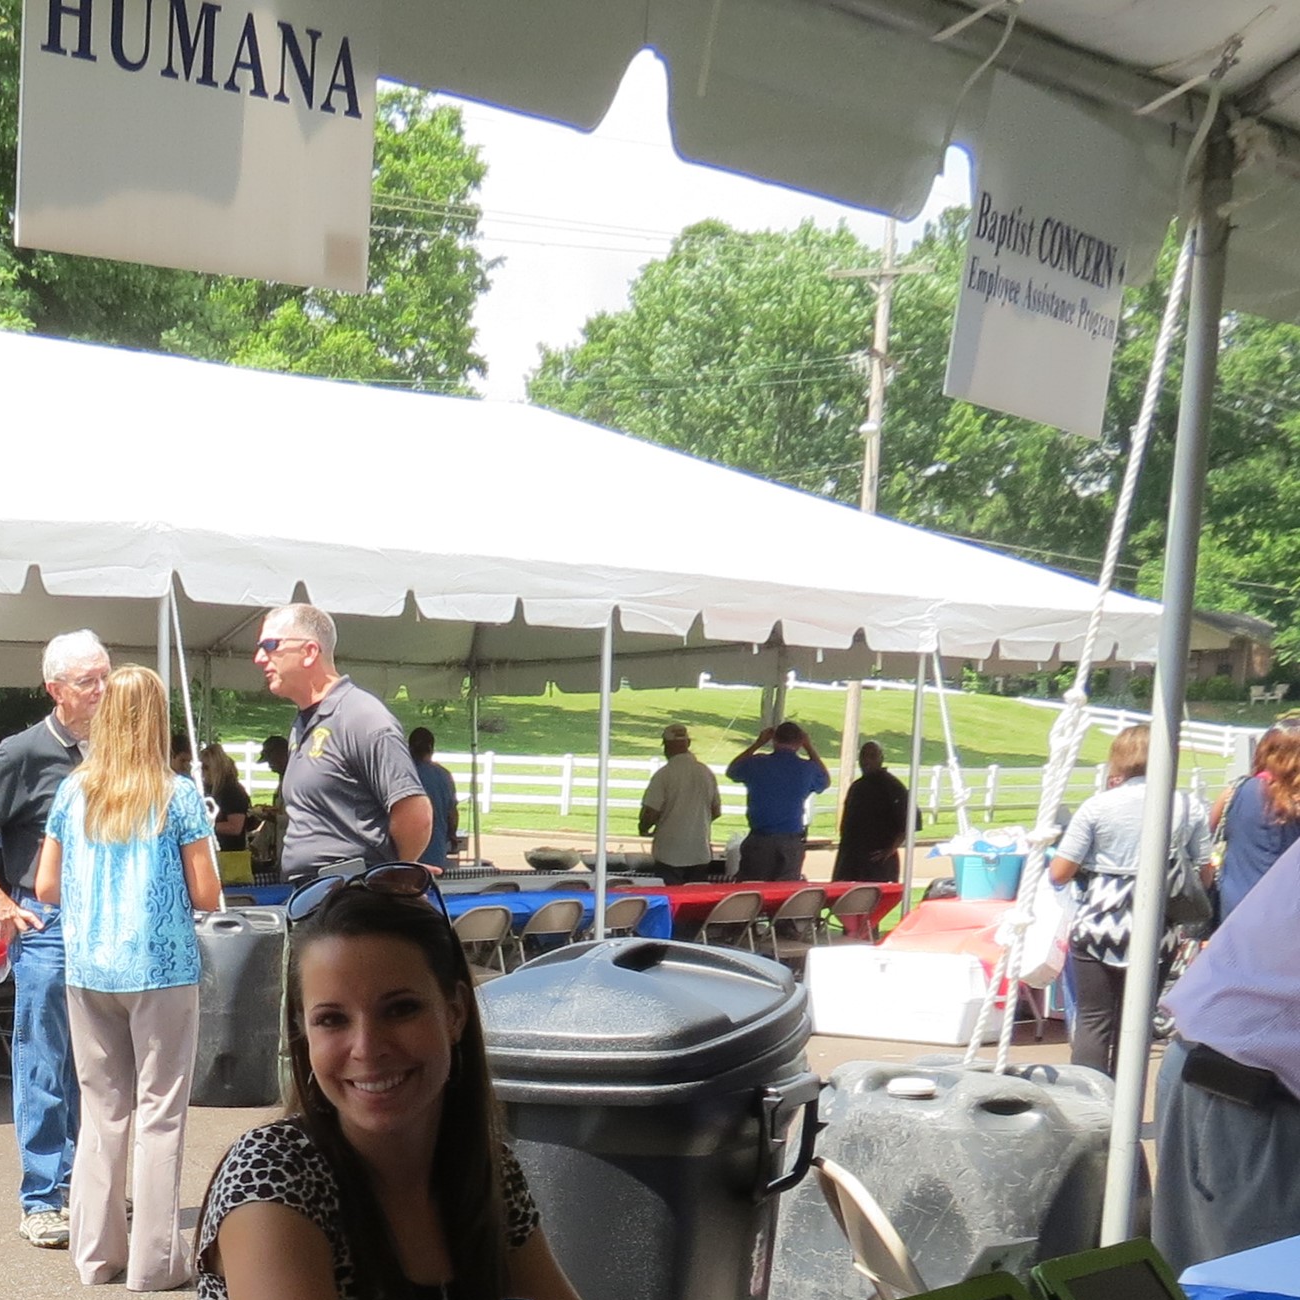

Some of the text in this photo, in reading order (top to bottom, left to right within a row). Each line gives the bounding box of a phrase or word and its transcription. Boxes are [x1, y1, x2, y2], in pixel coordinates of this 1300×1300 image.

[40, 0, 363, 120] HUMANA
[975, 191, 1118, 290] Baptist CONCERN
[967, 256, 1116, 341] Employee Assistance Program
